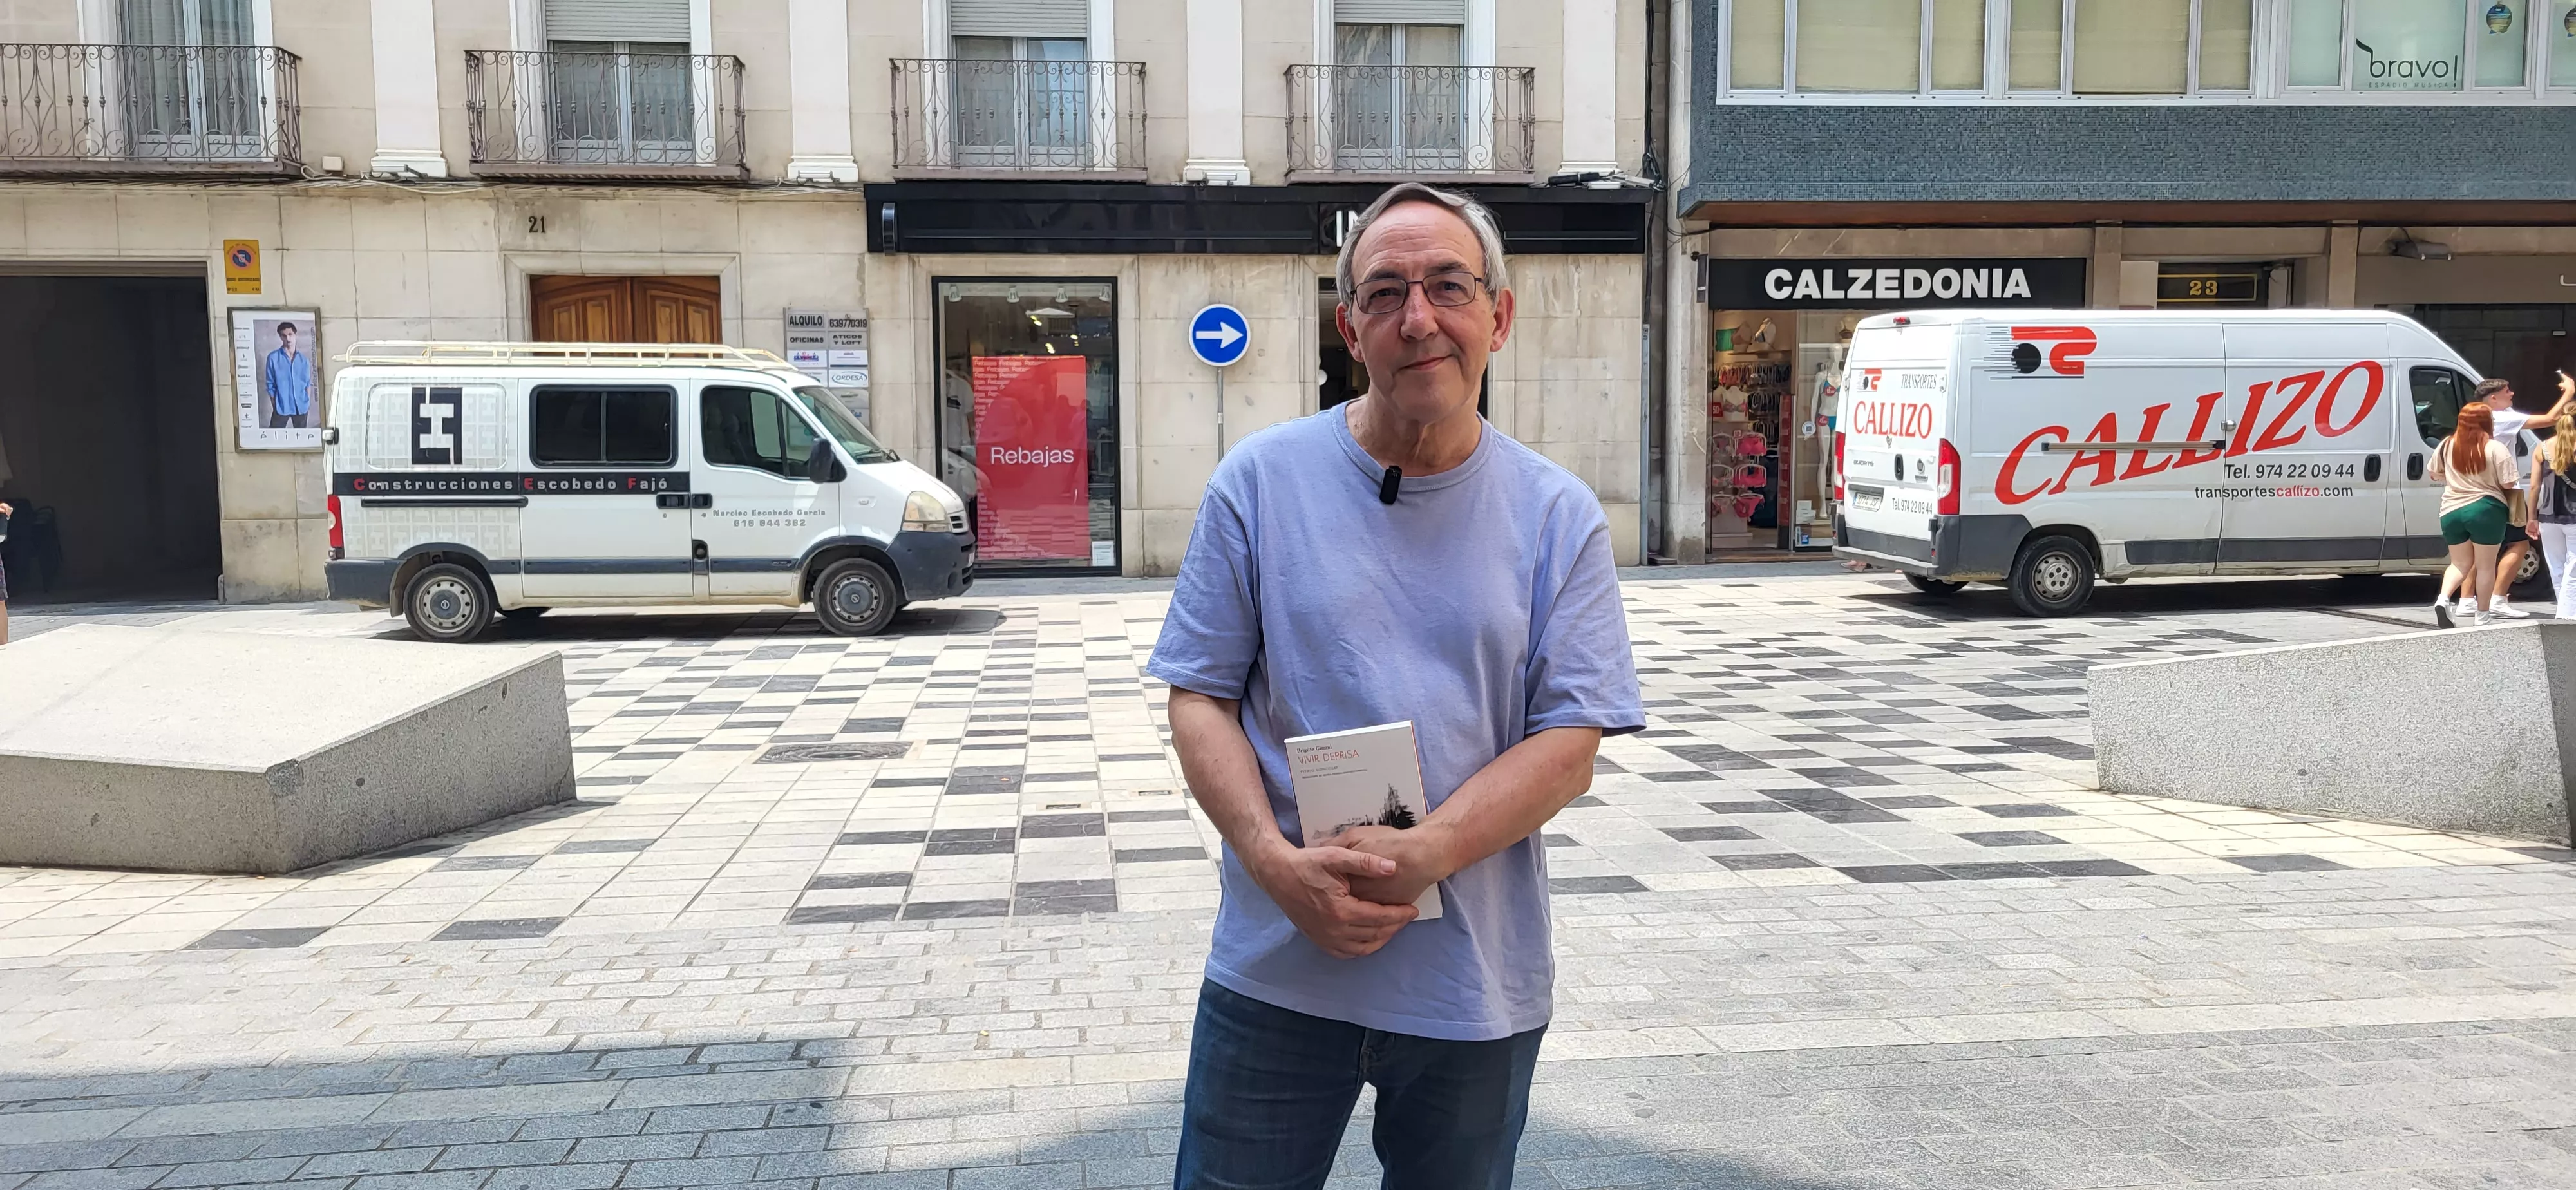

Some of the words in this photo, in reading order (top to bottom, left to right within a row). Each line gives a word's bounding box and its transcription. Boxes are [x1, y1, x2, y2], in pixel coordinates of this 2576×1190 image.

[528, 216, 546, 233] 21
[1765, 268, 2031, 300] CALZEDONIA
[2189, 280, 2218, 296] 23
[789, 316, 823, 326] ALQUILO
[829, 319, 867, 328] 639770319
[1901, 374, 1937, 389] TRANSPORTES
[1853, 401, 1933, 439] CALLIZO
[260, 430, 314, 440] élite
[1994, 360, 2384, 505] CALLIZO
[990, 446, 1074, 468] Rebajas
[2224, 464, 2251, 479] Tel.
[2255, 464, 2284, 479] 974
[2287, 464, 2307, 479] 22
[2311, 464, 2331, 479] 09
[2335, 464, 2354, 479] 44
[353, 478, 514, 491] Construcciones
[524, 477, 617, 491] Escobedo
[627, 477, 668, 492] Fajó
[2194, 485, 2353, 502] transportescallizo.com
[1901, 499, 1910, 512] 974
[1911, 500, 1918, 513] 22
[1918, 502, 1925, 515] 09
[1926, 502, 1933, 515] 44
[1298, 754, 1320, 764] VIVIR
[1323, 750, 1359, 762] DEPRISA
